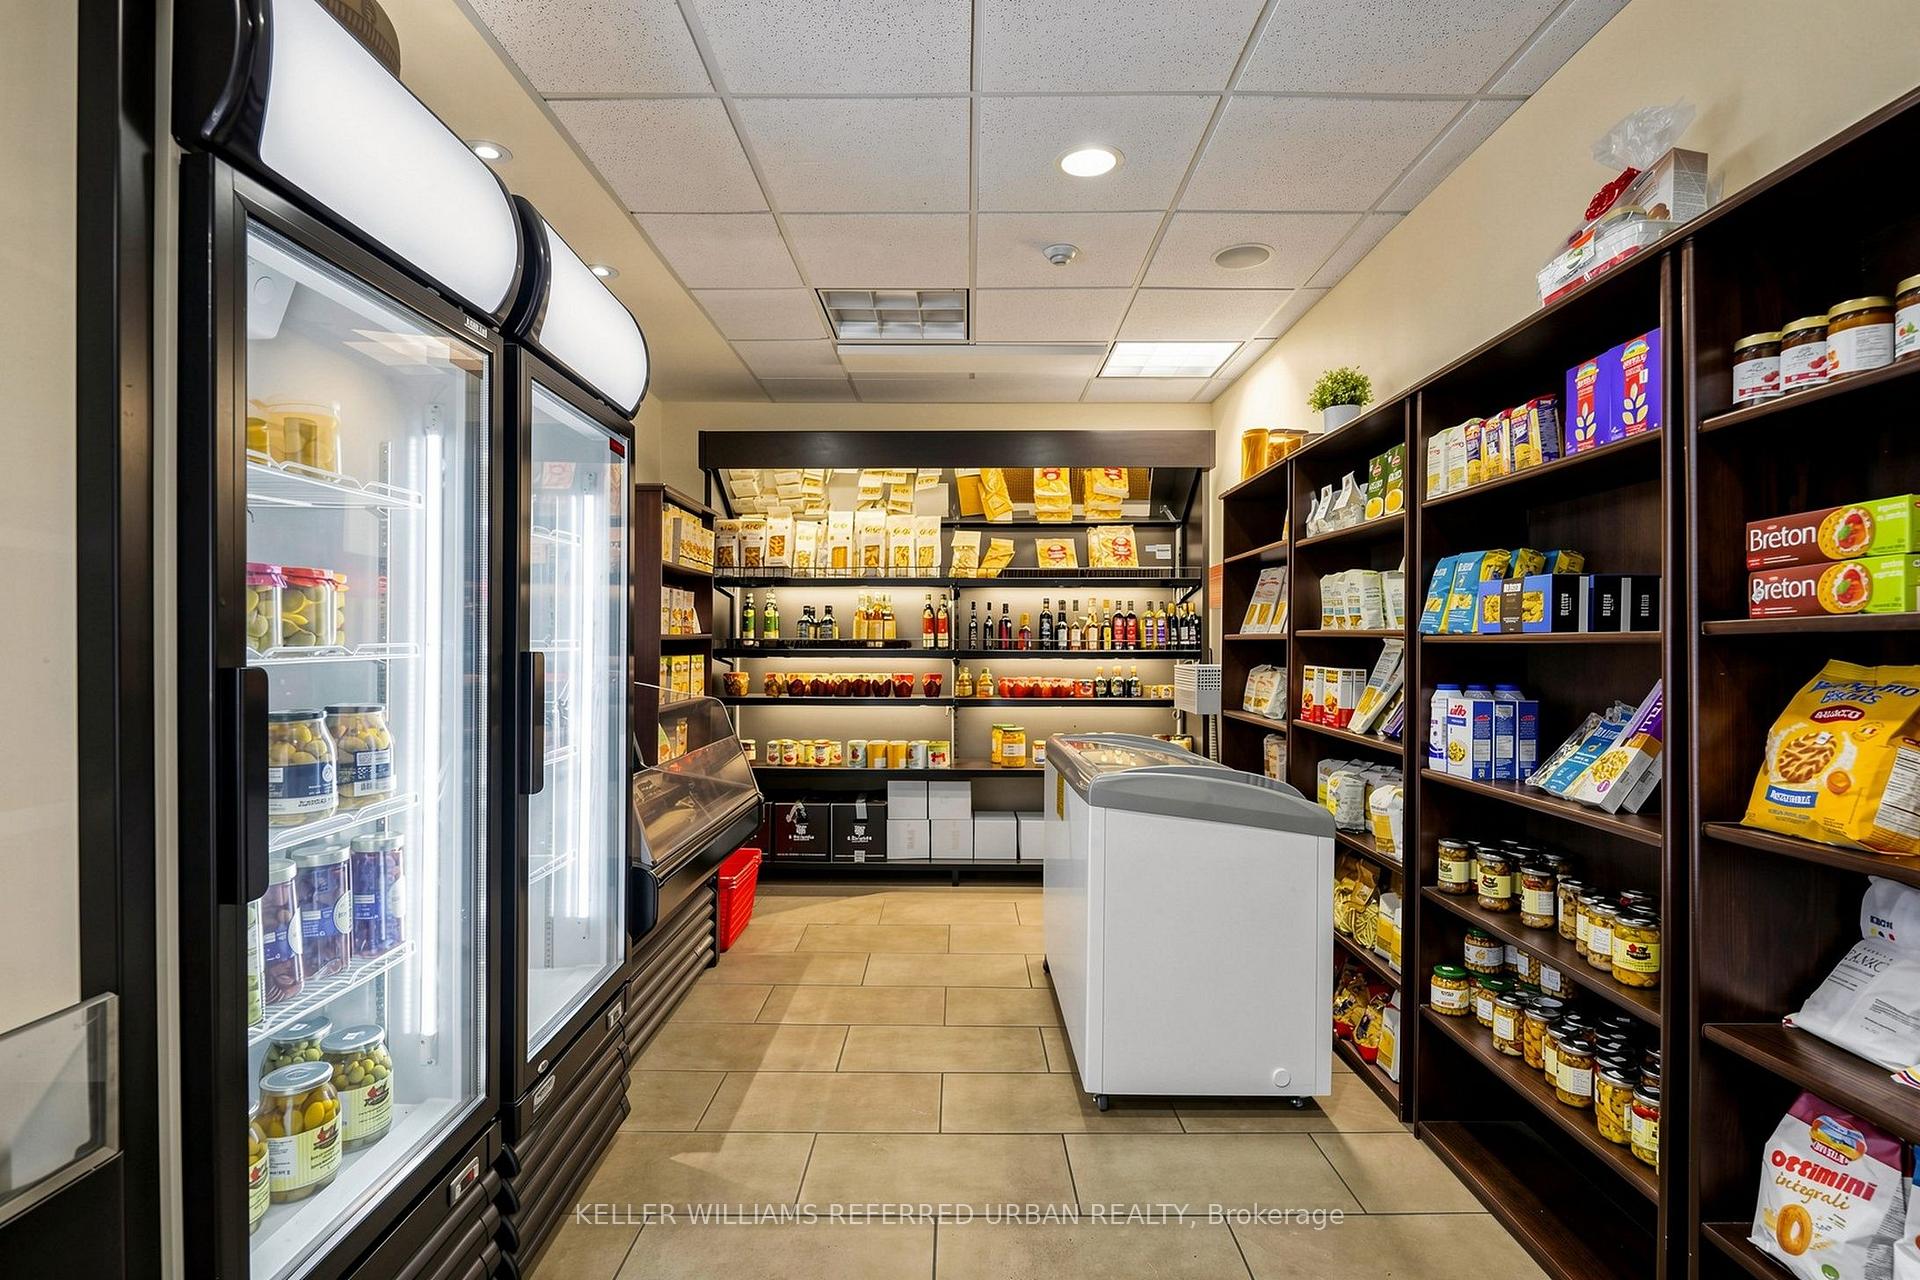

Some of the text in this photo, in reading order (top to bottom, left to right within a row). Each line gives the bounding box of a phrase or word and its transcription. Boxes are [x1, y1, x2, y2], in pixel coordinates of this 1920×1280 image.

[1750, 526, 1816, 552] Breton
[1753, 578, 1816, 601] Breton
[1775, 1172, 1850, 1210] integrali
